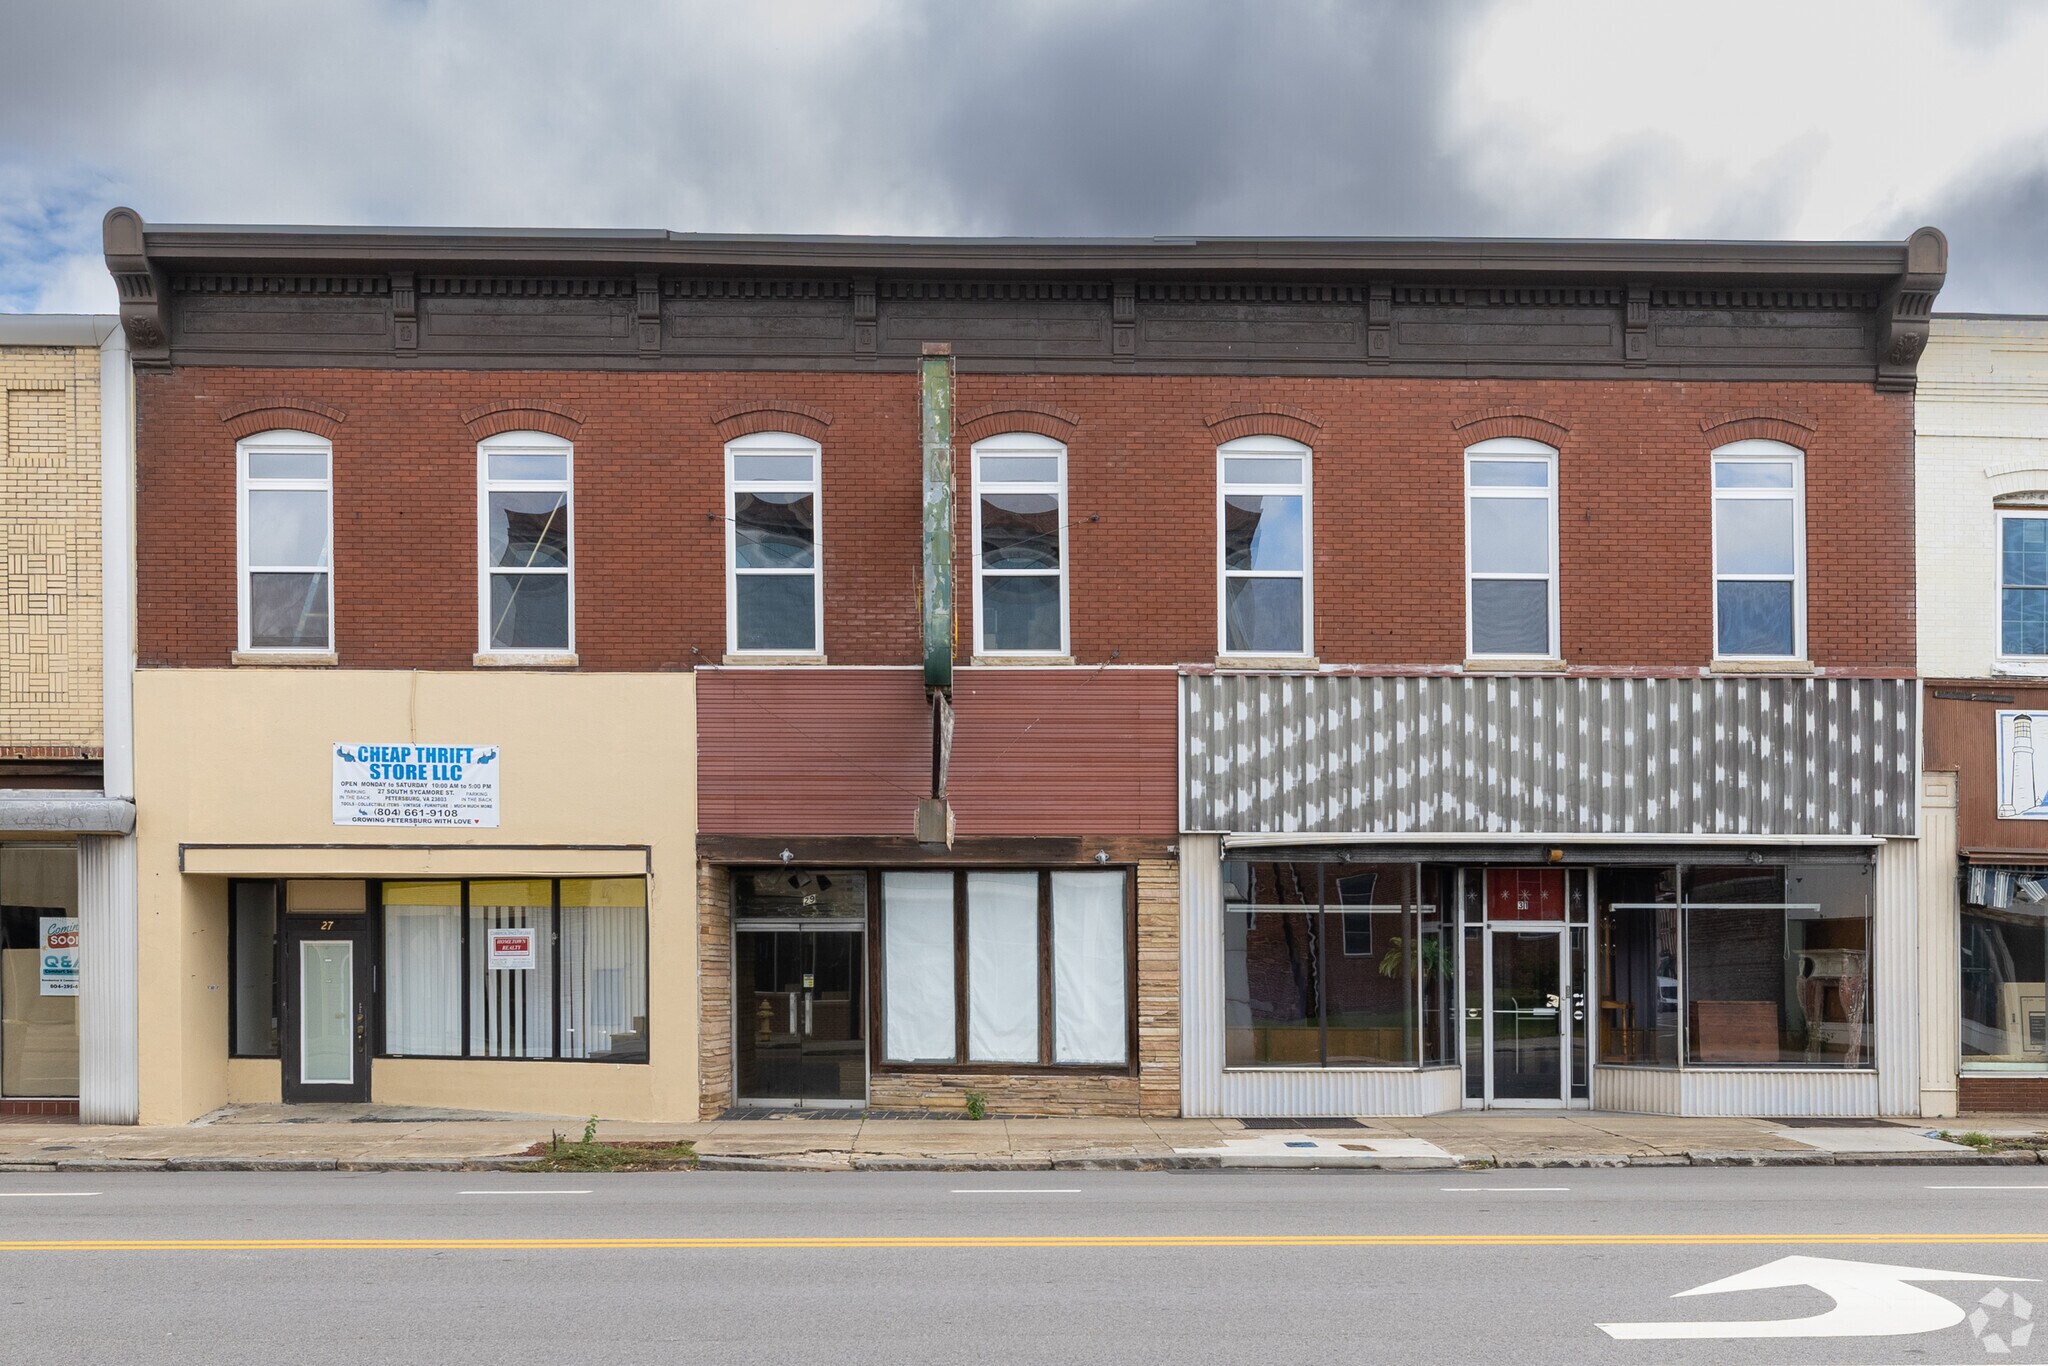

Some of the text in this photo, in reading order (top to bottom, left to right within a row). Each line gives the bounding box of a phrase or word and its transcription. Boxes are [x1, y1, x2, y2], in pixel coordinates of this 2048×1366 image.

[358, 746, 474, 764] CHEAP THRIFT
[369, 763, 463, 781] STORE LLC
[373, 808, 458, 817] (804) 661-9108
[804, 895, 815, 905] 29
[1518, 901, 1528, 909] 31
[320, 920, 334, 930] 27
